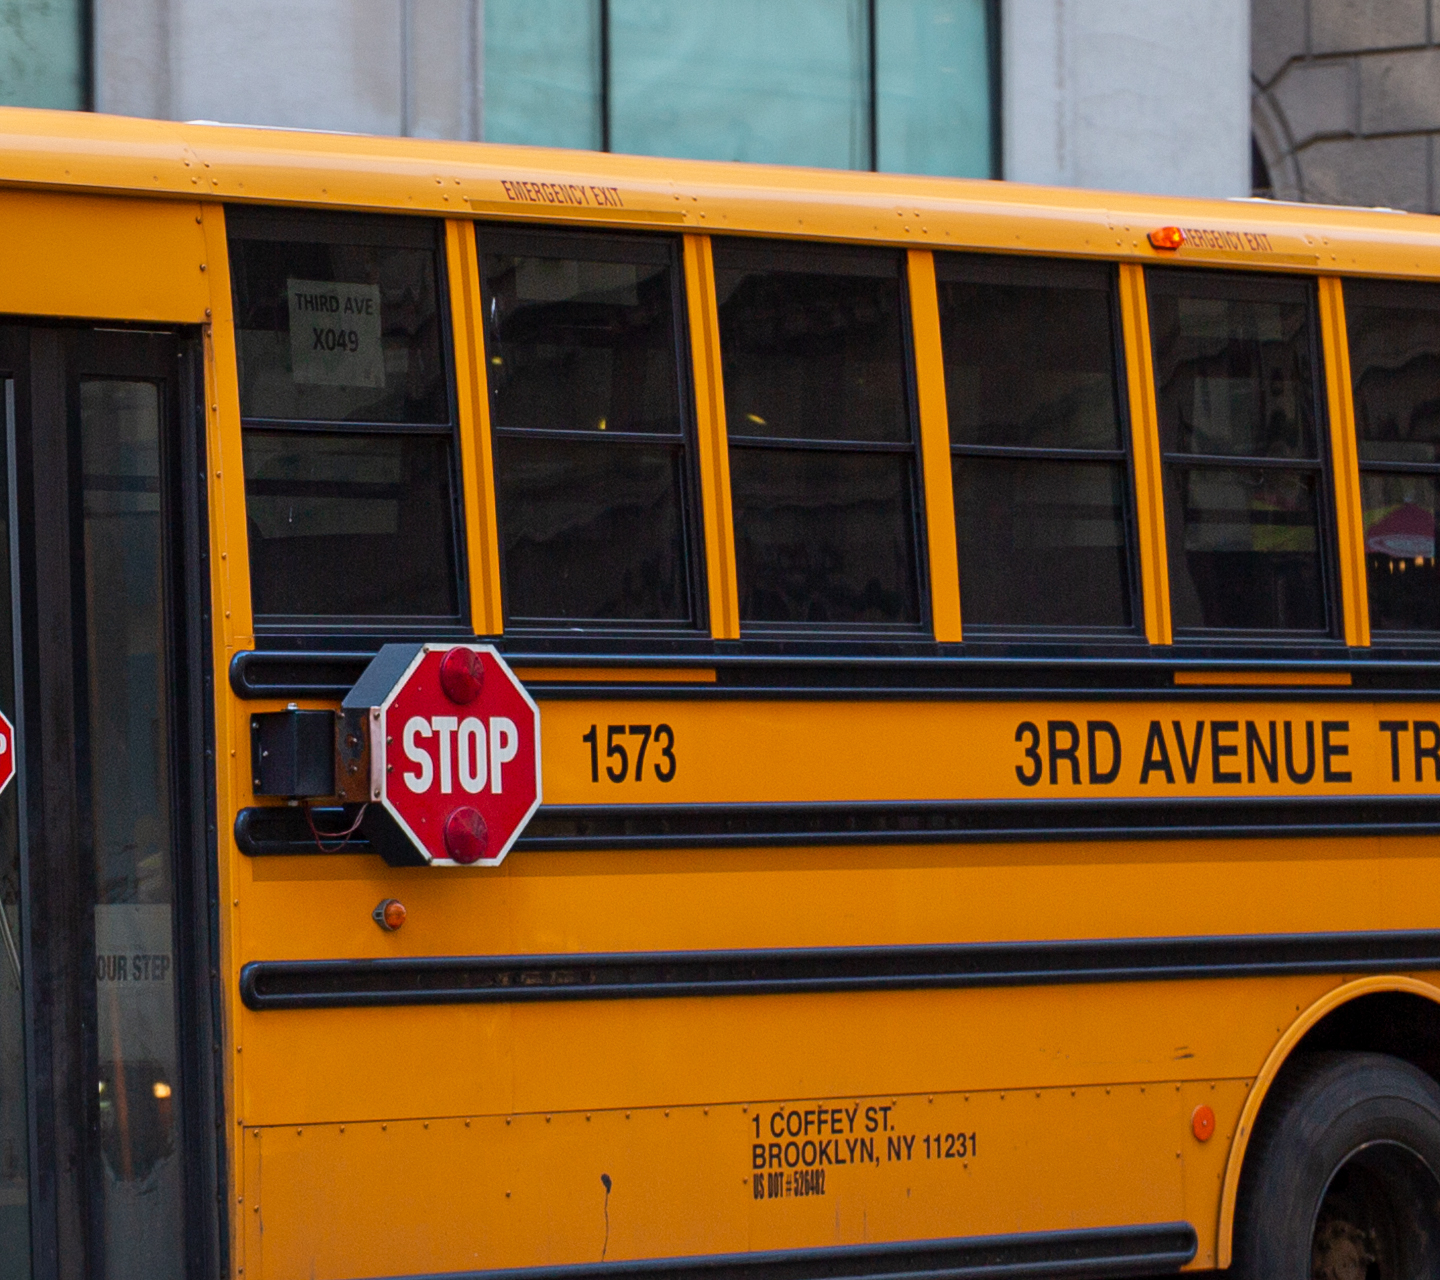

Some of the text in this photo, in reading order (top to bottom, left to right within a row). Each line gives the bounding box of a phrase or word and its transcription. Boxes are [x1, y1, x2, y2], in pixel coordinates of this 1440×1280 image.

[500, 180, 624, 207] EMERGENCY EXIT
[1182, 228, 1274, 252] MERGENCY EXIT
[294, 293, 374, 315] THIRD AVE
[312, 327, 359, 353] X049
[402, 715, 519, 794] STOP
[582, 723, 677, 784] 1573
[1014, 720, 1122, 787] 3RD
[1138, 720, 1353, 785] AVENUE
[95, 953, 171, 982] OUR STEP
[752, 1106, 895, 1139] 1 COFFEY ST.
[752, 1131, 977, 1170] BROOKLYN, NY 11231
[752, 1172, 766, 1200] US
[767, 1171, 784, 1199] DOT
